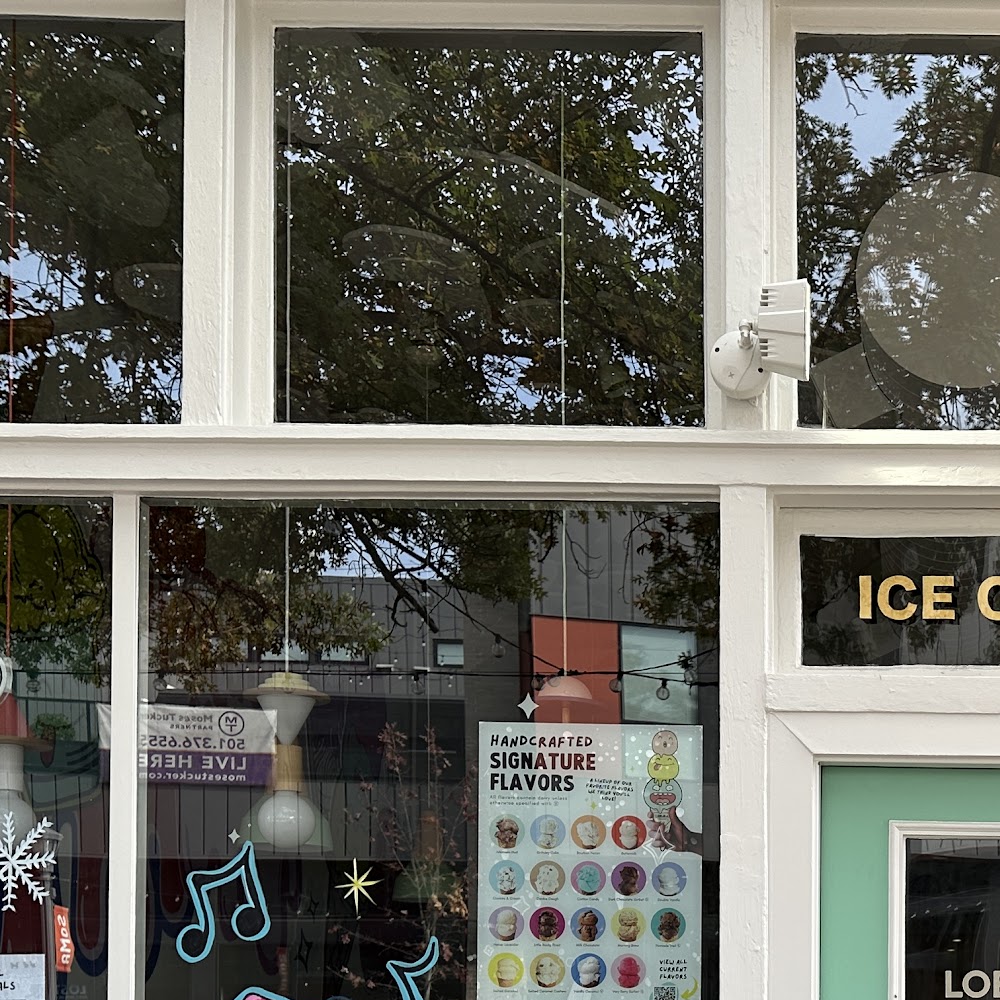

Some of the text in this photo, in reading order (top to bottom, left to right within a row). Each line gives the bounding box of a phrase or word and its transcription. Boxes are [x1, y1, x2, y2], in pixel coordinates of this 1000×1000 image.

[858, 575, 957, 622] ICE
[490, 734, 593, 748] HANDCRAFTED
[490, 752, 596, 771] SIGNATURE
[490, 773, 575, 791] FLAVORS
